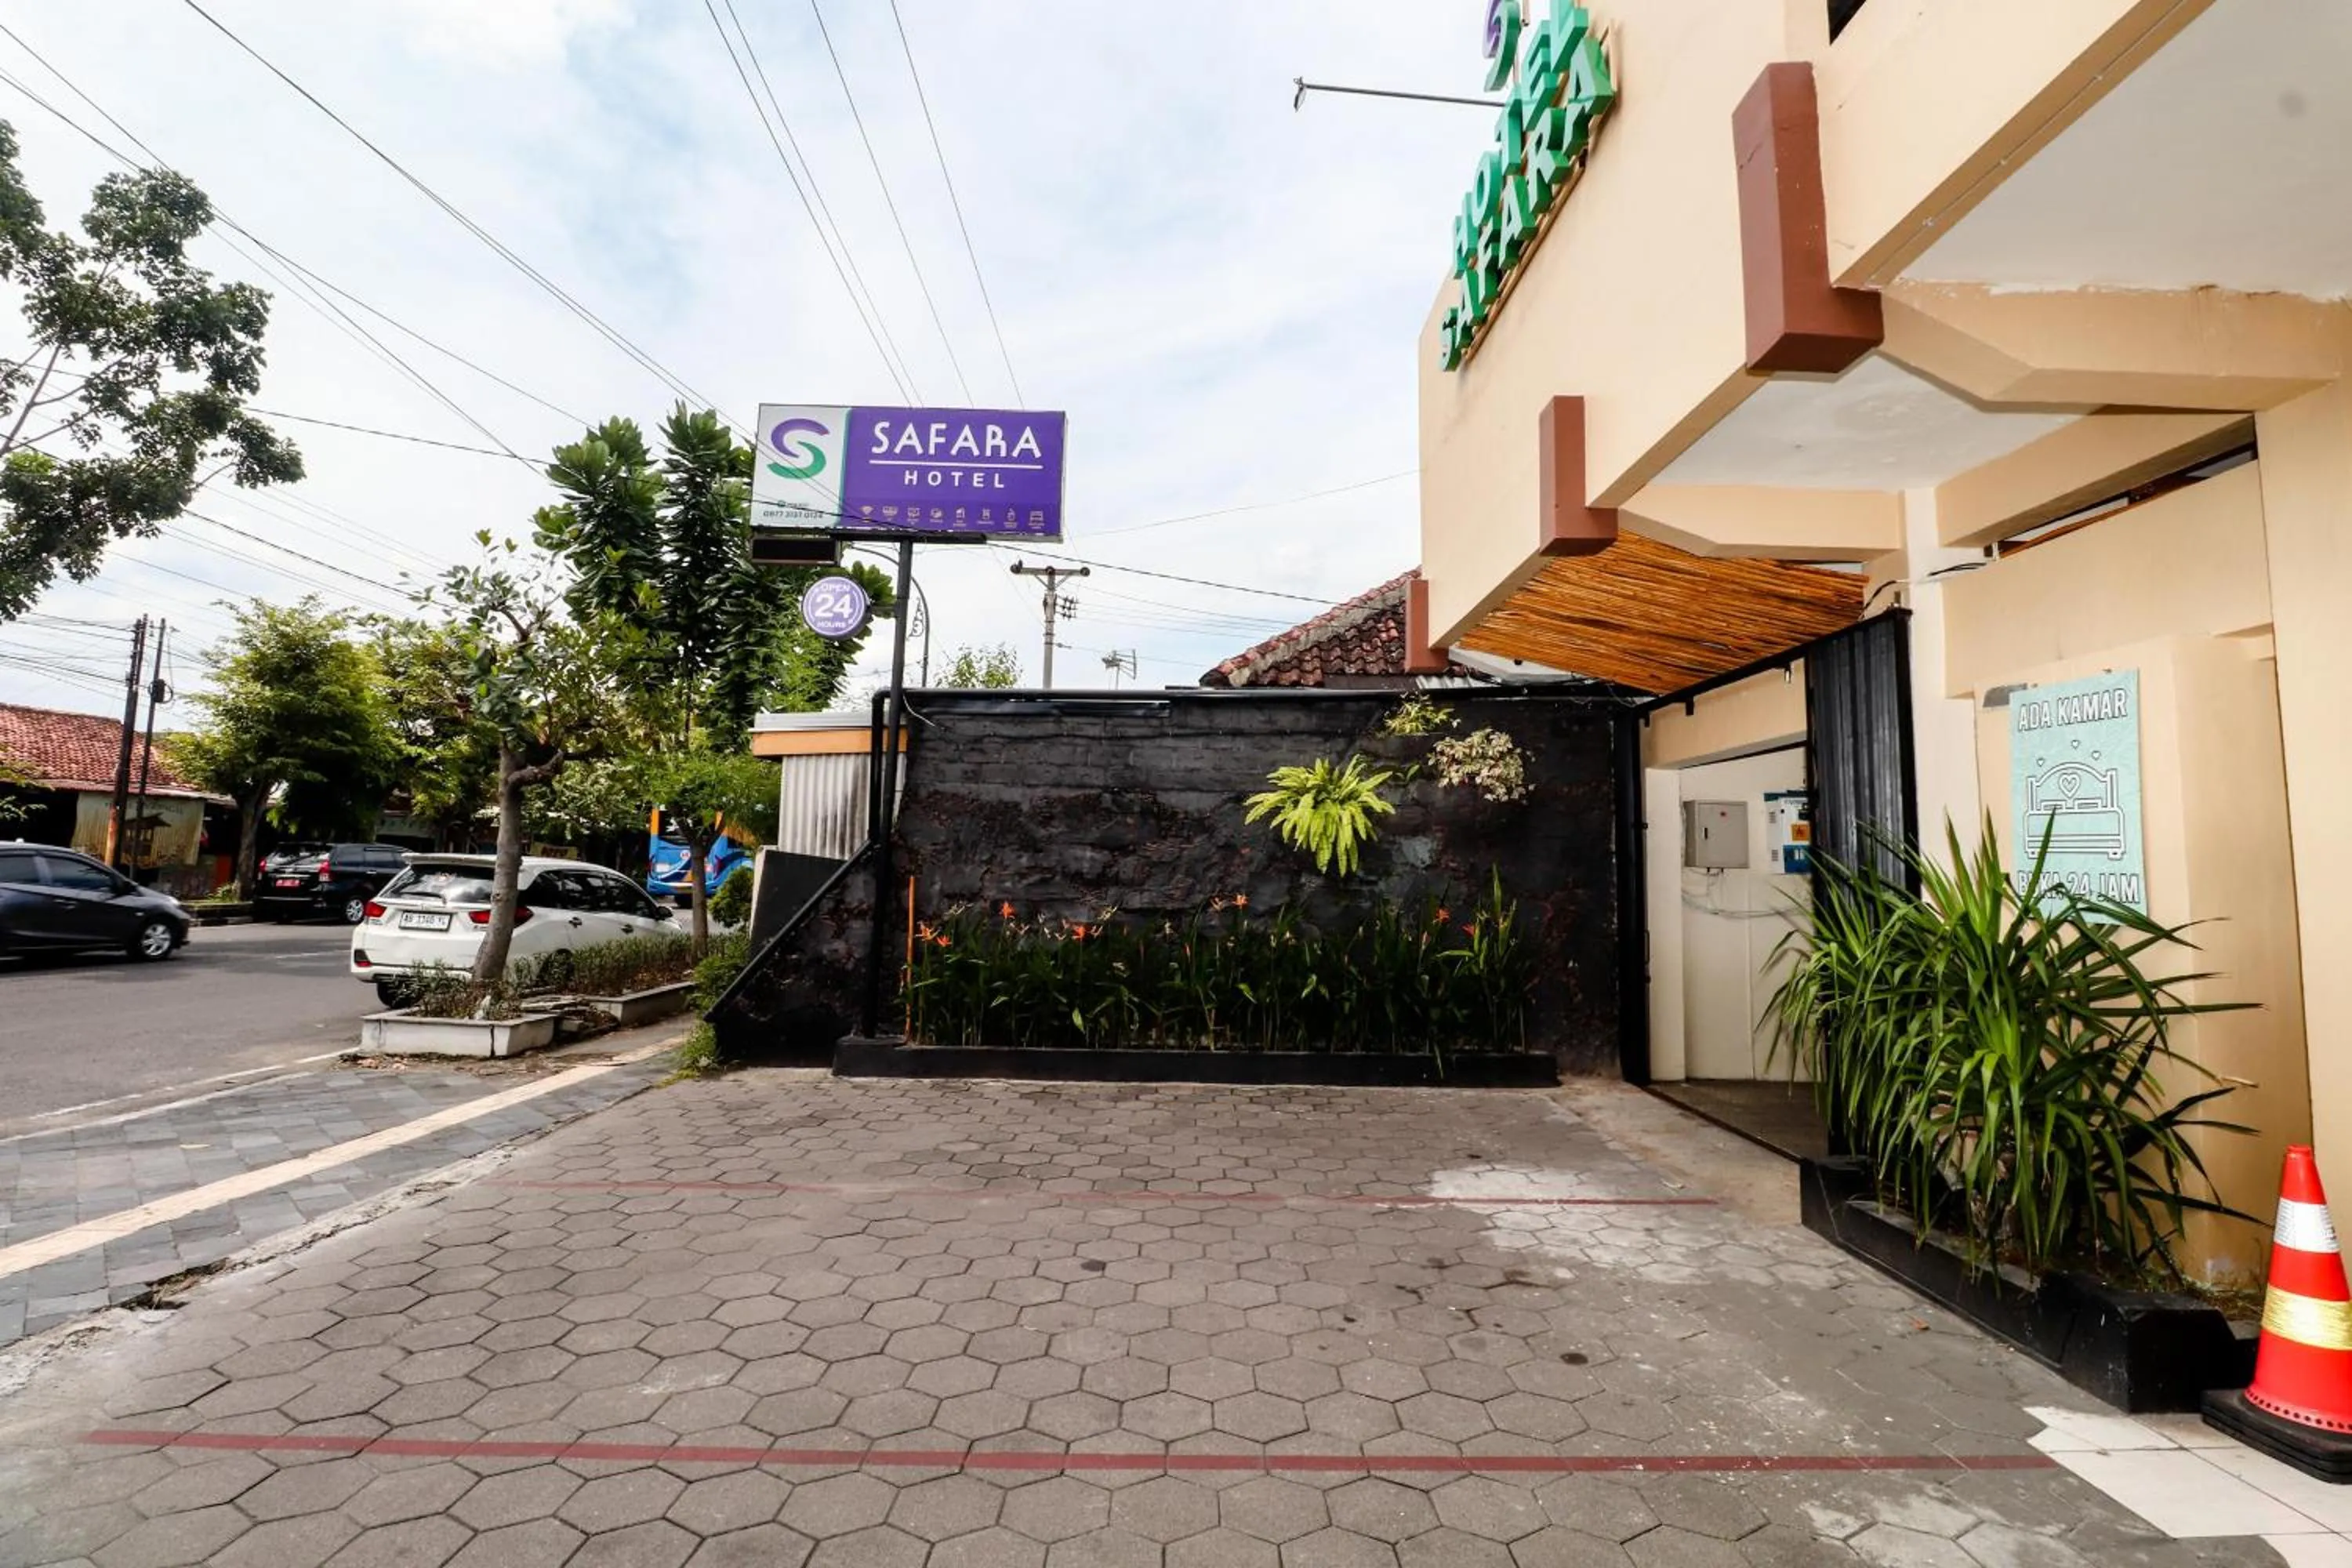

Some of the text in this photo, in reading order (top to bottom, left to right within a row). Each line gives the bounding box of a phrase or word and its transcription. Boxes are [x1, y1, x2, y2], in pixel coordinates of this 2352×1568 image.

[1440, 36, 1616, 372] SAFARA
[871, 420, 1043, 459] SAFARA
[903, 470, 1005, 488] HOTEL
[820, 583, 851, 592] OPEN
[815, 593, 854, 619] 24
[2017, 688, 2128, 732] ADA KAMAR
[2016, 869, 2141, 904] BKA 24 JAM
